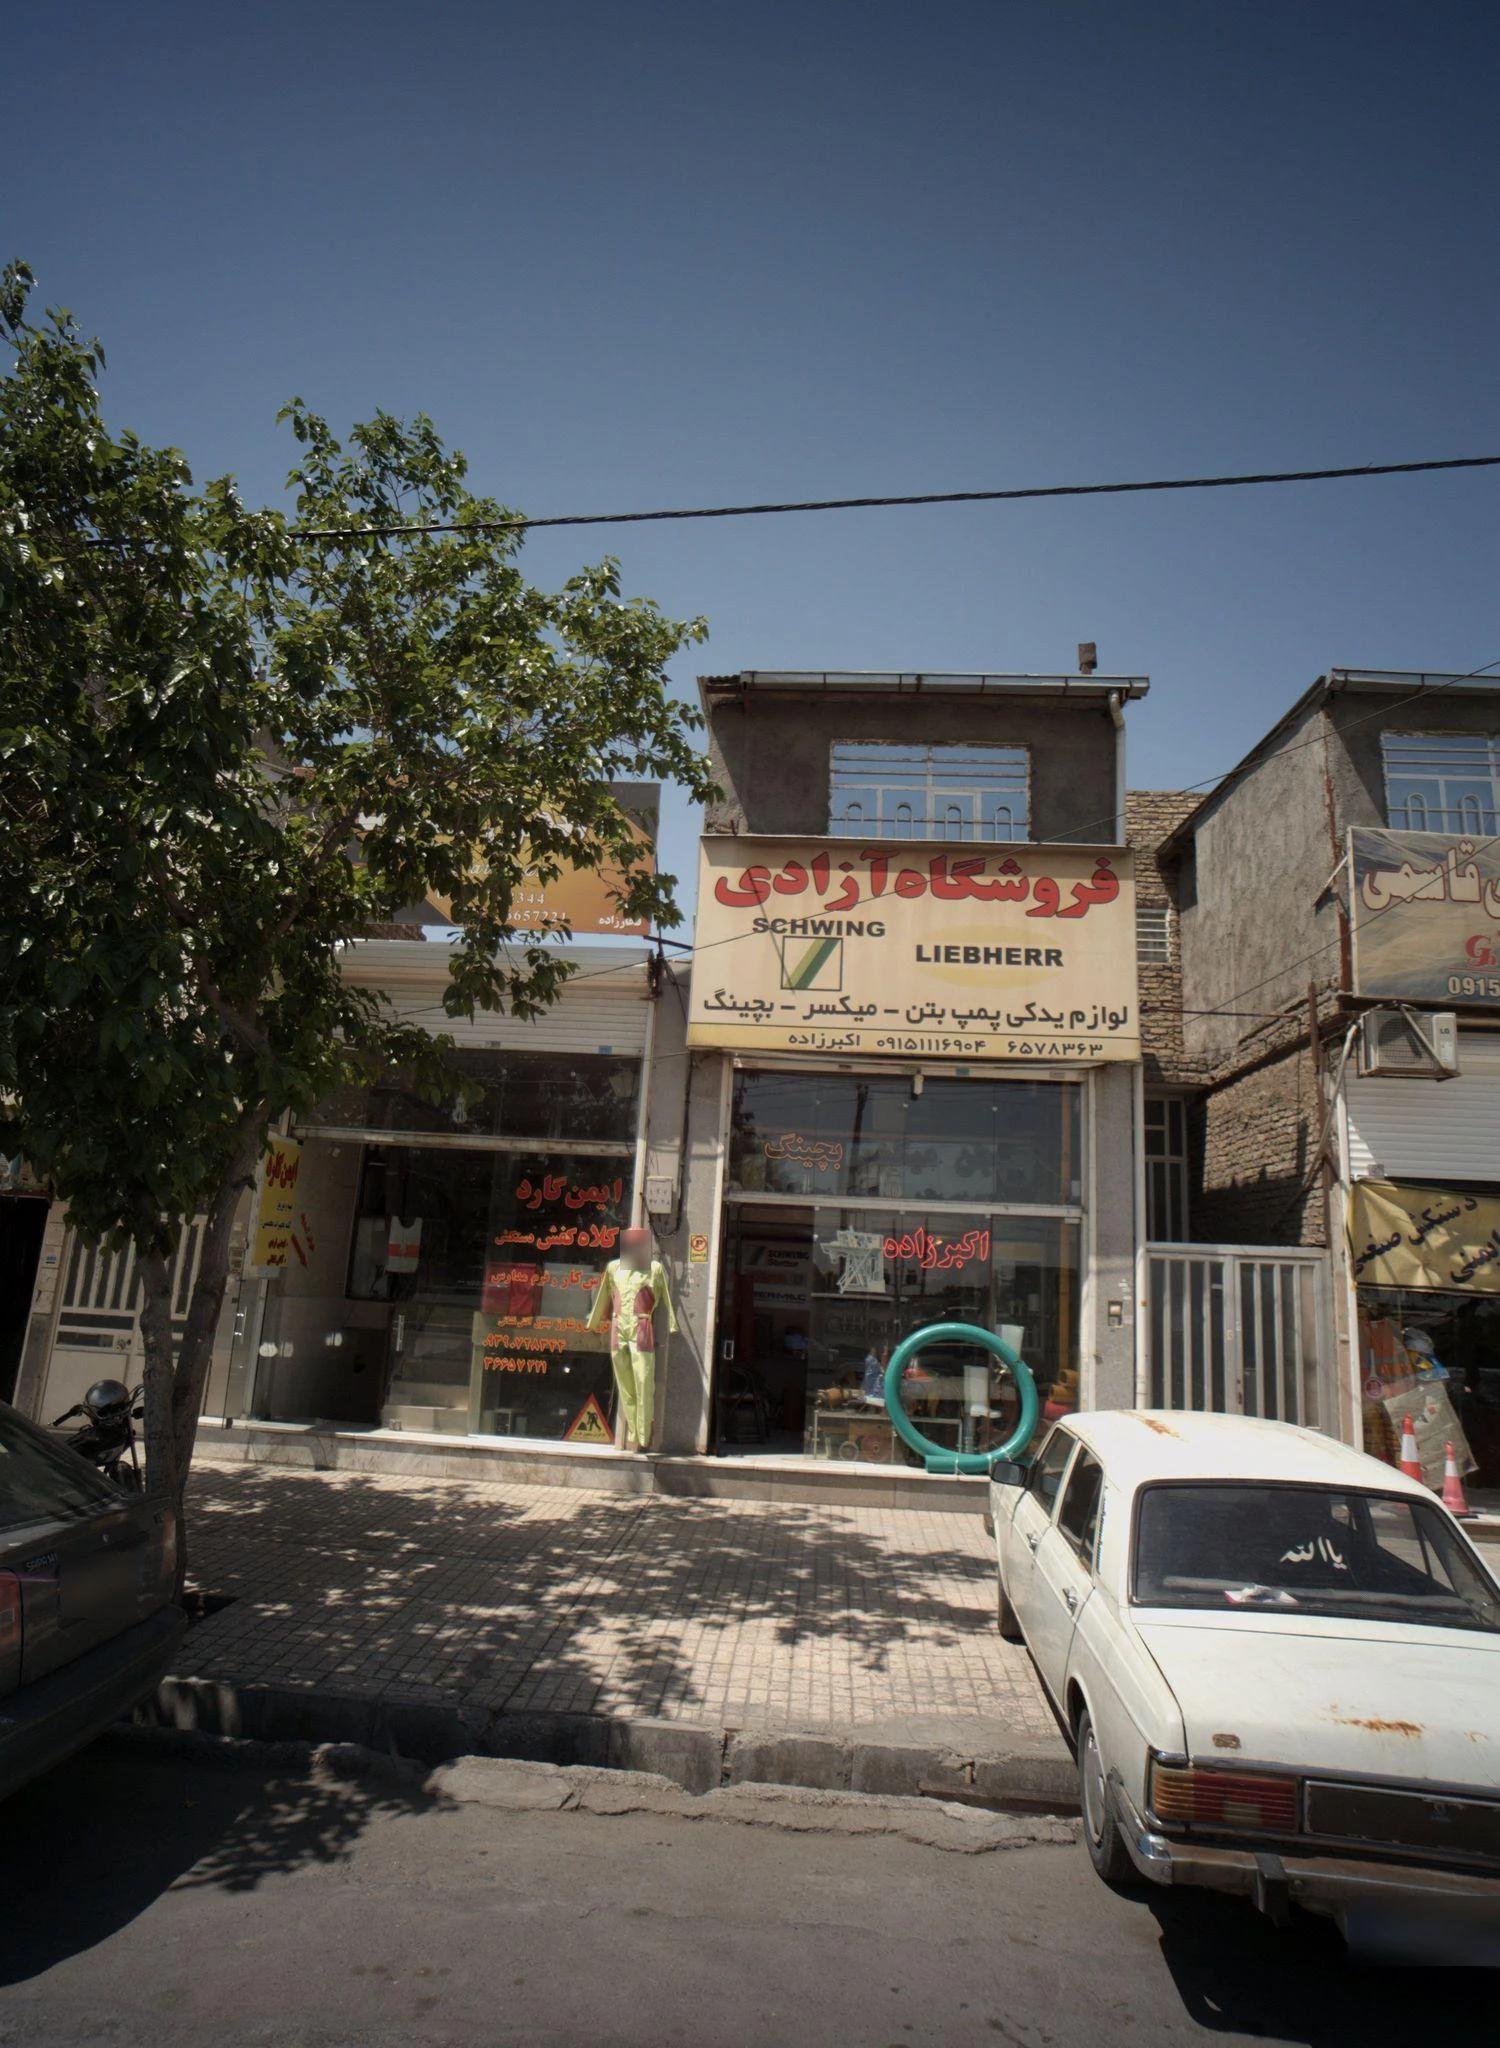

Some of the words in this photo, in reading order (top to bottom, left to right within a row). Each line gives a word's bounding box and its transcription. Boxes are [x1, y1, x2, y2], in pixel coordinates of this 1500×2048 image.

[714, 849, 899, 911] آزادی
[895, 856, 1120, 919] فروشگاه
[752, 917, 886, 938] SCHWING
[915, 944, 1064, 968] LIEBHERR
[703, 988, 776, 1023] بچینگ
[802, 995, 878, 1023] میکسر
[904, 1001, 947, 1027] بتن
[950, 1006, 1001, 1032] پمپ
[1006, 1001, 1065, 1030] یدکی
[1069, 1004, 1128, 1032] لوازم
[1007, 1040, 1104, 1056] ۶۵۷۸۳۶۳
[763, 1132, 844, 1171] بچینگ
[564, 1177, 623, 1211] ایمن
[536, 1225, 578, 1251] کفش
[577, 1223, 620, 1248] کلاه
